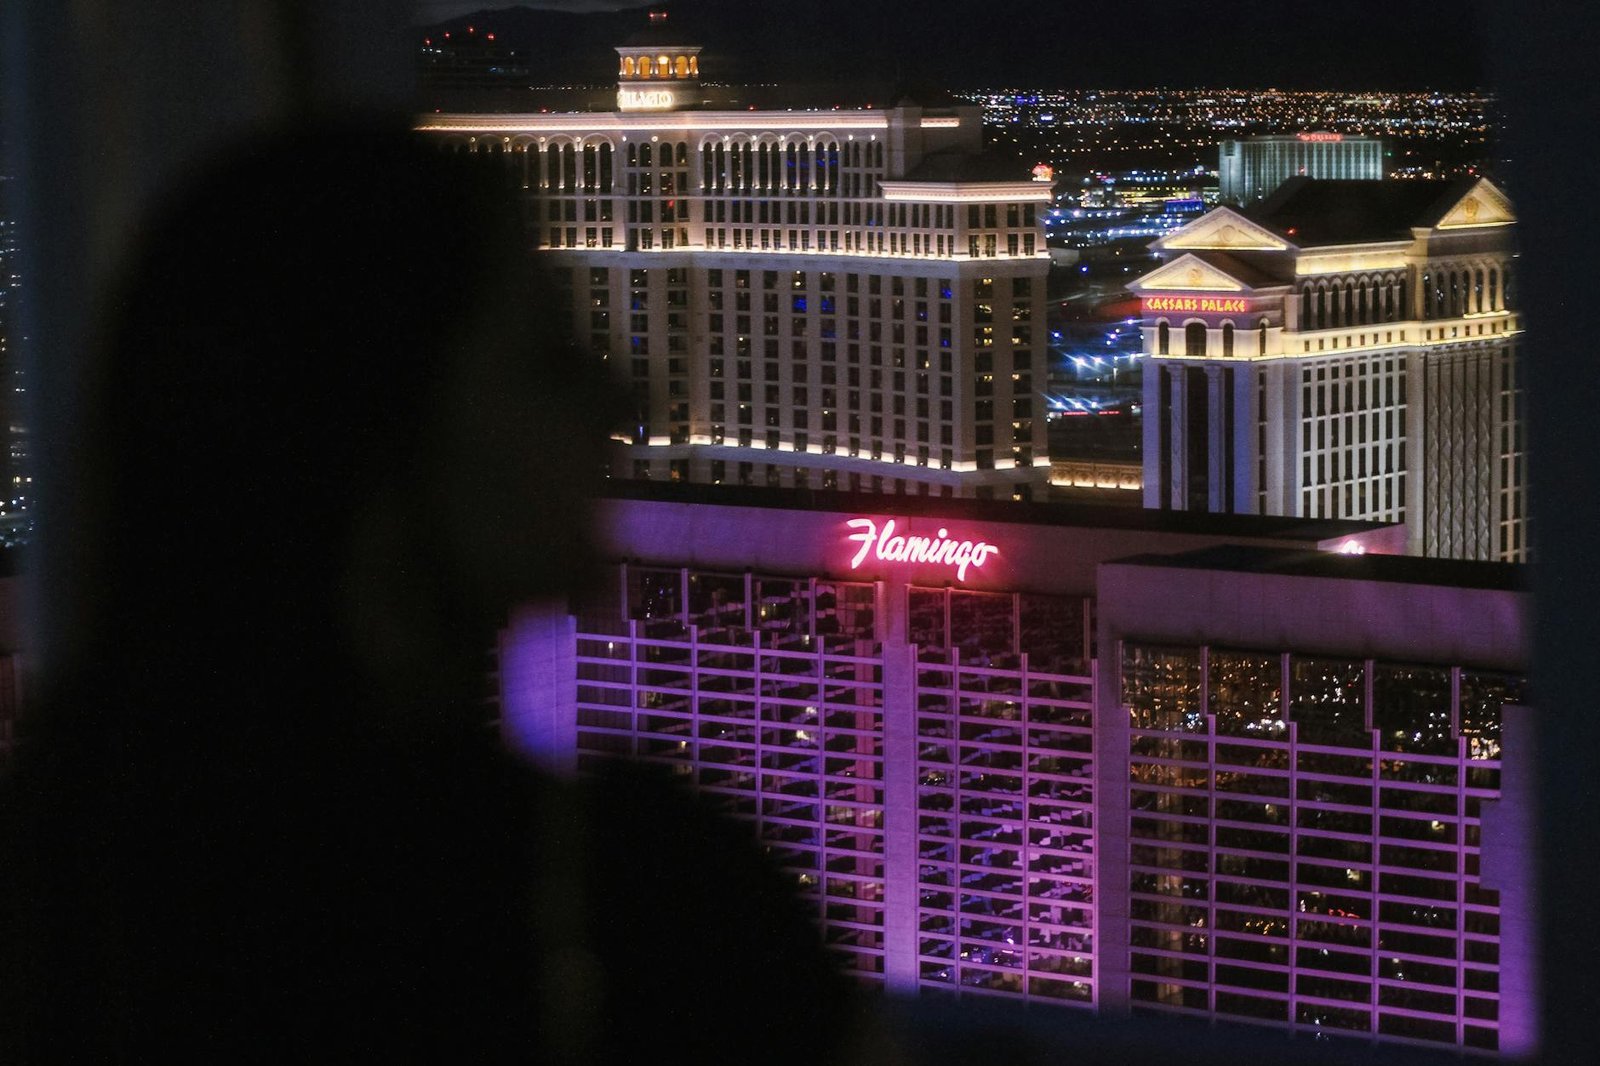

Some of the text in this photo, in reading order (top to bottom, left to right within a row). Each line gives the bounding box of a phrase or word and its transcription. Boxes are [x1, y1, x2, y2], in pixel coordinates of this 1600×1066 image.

[1146, 298, 1245, 312] CAESARS PALACE
[846, 518, 999, 582] Flamingo
